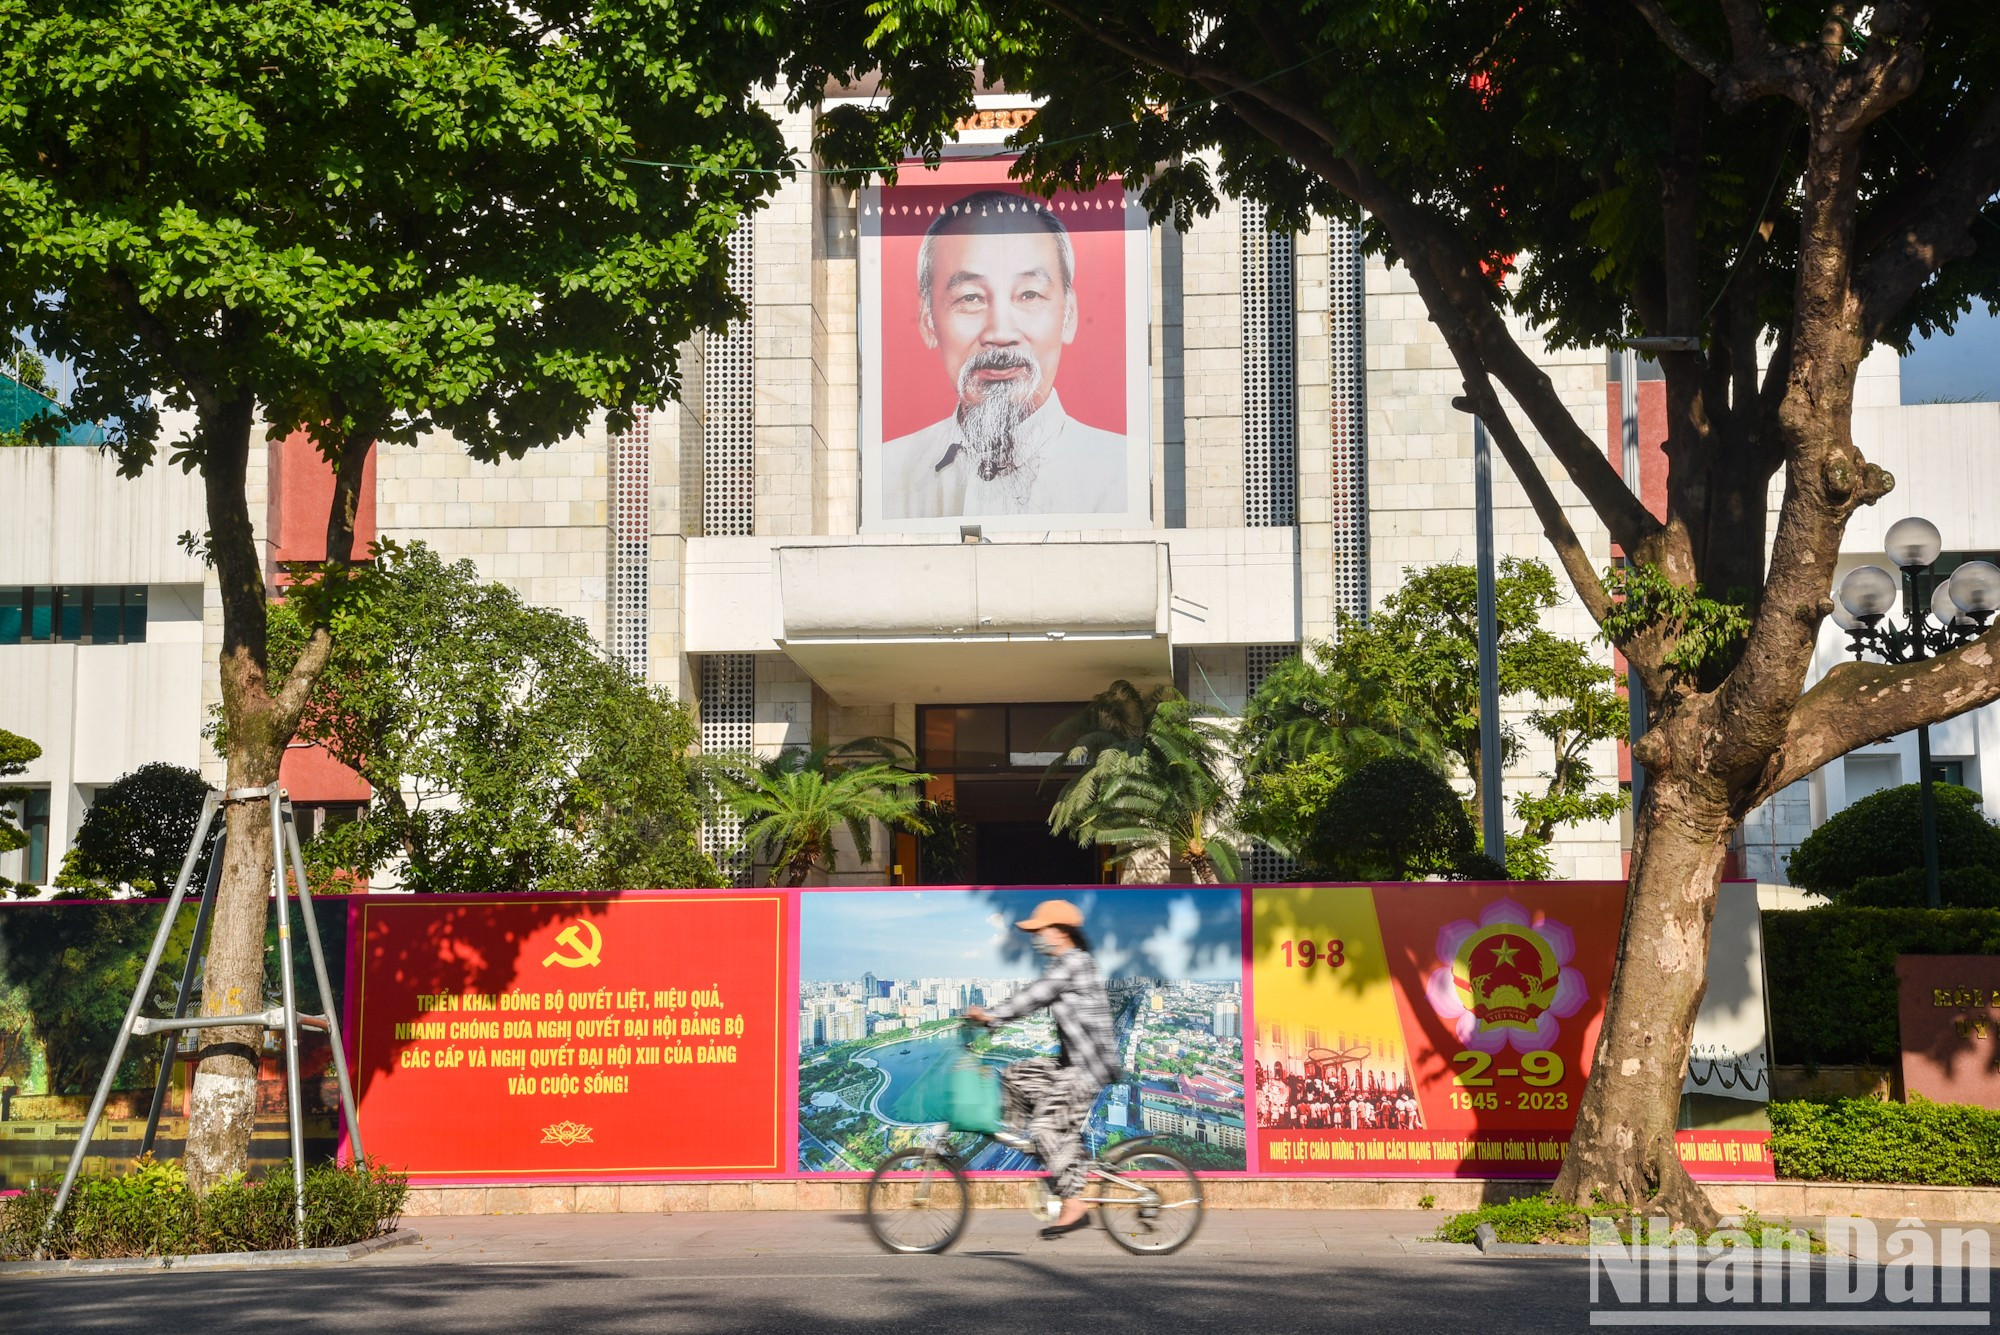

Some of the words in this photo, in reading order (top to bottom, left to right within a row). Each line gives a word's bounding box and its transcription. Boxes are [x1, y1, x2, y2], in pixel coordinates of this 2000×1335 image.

[1280, 939, 1345, 969] 19-8
[417, 988, 458, 1011] TRIỂN
[463, 994, 496, 1011] KHAI
[500, 988, 540, 1011] ĐỒNG
[545, 989, 564, 1013] BỘ
[568, 986, 613, 1011] QUYẾT
[617, 988, 650, 1012] LIỆT,
[654, 987, 686, 1012] HIỆU
[691, 983, 724, 1010] QUẢ,
[395, 1022, 445, 1040] NHANH
[450, 1018, 499, 1040] CHÓNG
[503, 1020, 533, 1039] ĐƯA
[537, 1020, 572, 1041] NGHỊ
[576, 1014, 620, 1039] QUYẾT
[624, 1019, 649, 1040] ĐẠI
[653, 1015, 677, 1040] HỘI
[681, 1011, 721, 1036] ĐẢNG
[725, 1014, 744, 1038] BỘ
[401, 1047, 431, 1068] CÁC
[434, 1044, 464, 1068] CẤP
[468, 1046, 487, 1067] VÀ
[491, 1050, 526, 1071] NGHỊ
[530, 1042, 575, 1068] QUYẾT
[578, 1048, 603, 1069] ĐẠI
[607, 1044, 631, 1069] HỘI
[635, 1046, 660, 1065] XIII
[664, 1039, 693, 1064] CỦA
[697, 1038, 737, 1064] ĐẢNG
[1452, 1050, 1565, 1087] 2-9
[508, 1073, 537, 1095] VÀO
[540, 1073, 579, 1098] CUỘC
[584, 1070, 629, 1094] SỐNG!
[1449, 1092, 1498, 1111] 1945
[1518, 1092, 1569, 1110] 2023
[1270, 1138, 1291, 1164] NHIỆT
[1293, 1138, 1308, 1164] LIỆT
[1310, 1138, 1330, 1160] CHÀO
[1331, 1137, 1354, 1160] MỪNG
[1356, 1141, 1365, 1160] 78
[1367, 1138, 1385, 1160] NĂM
[1386, 1138, 1407, 1160] CÁCH
[1408, 1141, 1431, 1164] MẠNG
[1432, 1138, 1458, 1160] THÁNG
[1458, 1138, 1475, 1160] TÁM
[1477, 1138, 1502, 1160] THÀNH
[1504, 1138, 1525, 1160] CÔNG
[1526, 1138, 1537, 1160] VÀ
[1538, 1136, 1559, 1162] QUỐC
[1680, 1135, 1696, 1161] CHỦ
[1697, 1139, 1723, 1161] NGHĨA
[1723, 1138, 1741, 1166] VIỆT
[1742, 1143, 1762, 1162] NAM
